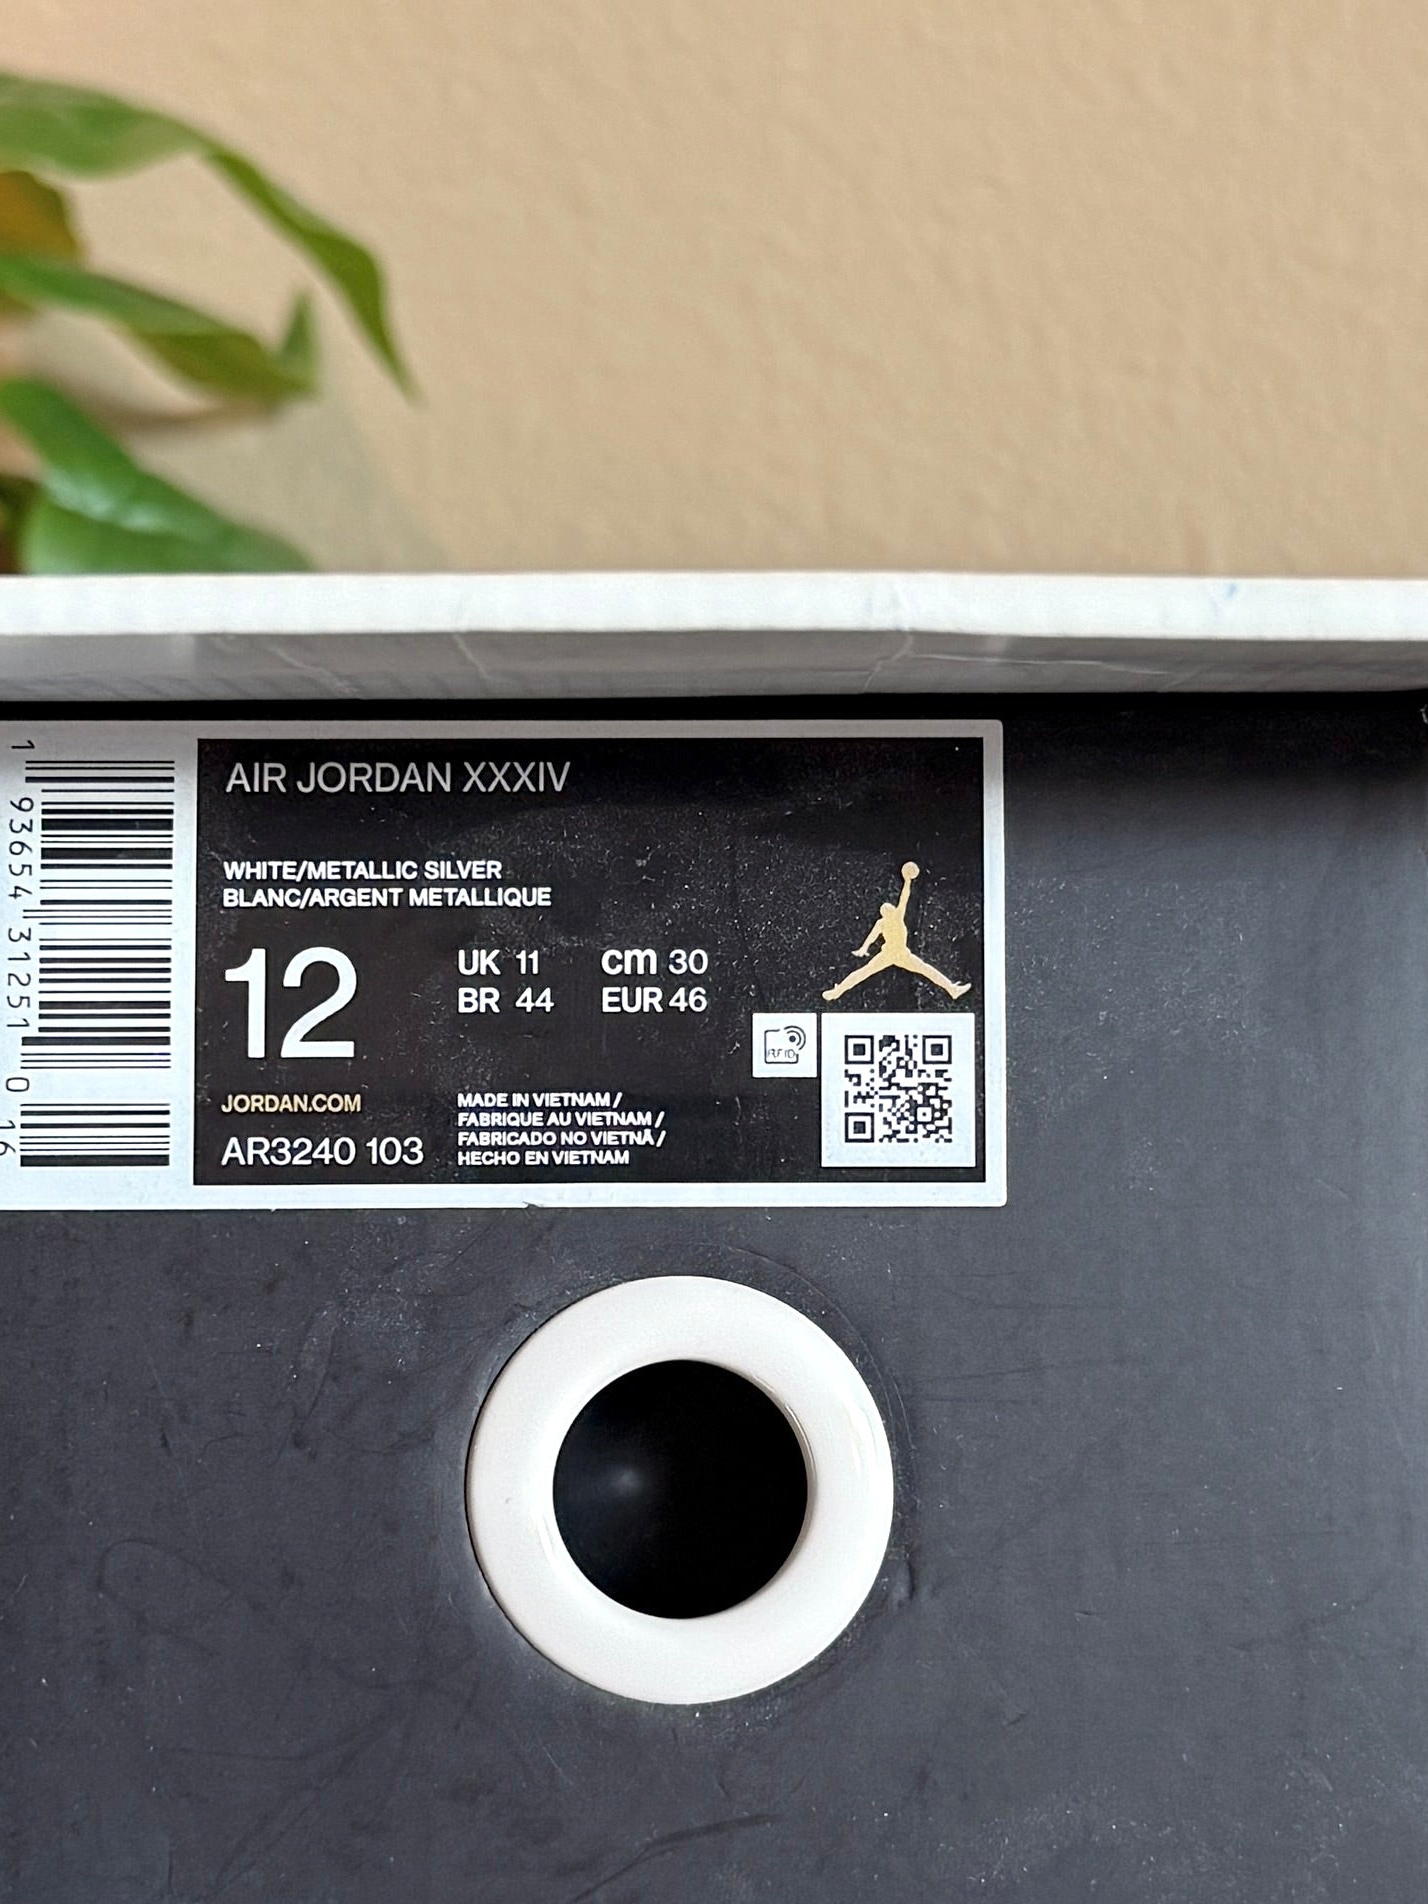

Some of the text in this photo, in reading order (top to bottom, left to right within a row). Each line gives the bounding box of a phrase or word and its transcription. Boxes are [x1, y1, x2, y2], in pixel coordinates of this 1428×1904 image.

[225, 760, 571, 794] AIR JORDAN XXXIV
[222, 859, 503, 882] WHITE/METALLIC SILVER
[222, 886, 553, 909] BLANC/ARGENT METALLIQUE
[5, 739, 35, 1093] 1 93654 31251 0
[457, 948, 540, 976] UK 11
[600, 947, 709, 976] cm 30
[224, 946, 358, 1059] 12
[457, 986, 555, 1014] BR 44
[601, 986, 708, 1014] EUR 46
[221, 1093, 362, 1113] JORDAN.COM
[457, 1092, 509, 1108] MADE
[511, 1092, 530, 1108] IN
[531, 1091, 611, 1108] VIETNAM
[457, 1111, 545, 1127] FABRIQUE
[546, 1111, 572, 1127] AU
[574, 1110, 653, 1127] VIETNAM
[221, 1136, 424, 1166] AR3240 103
[457, 1130, 557, 1147] FABRICADO
[560, 1130, 588, 1146] NO
[457, 1149, 630, 1166] HECHO EN VIETNAM
